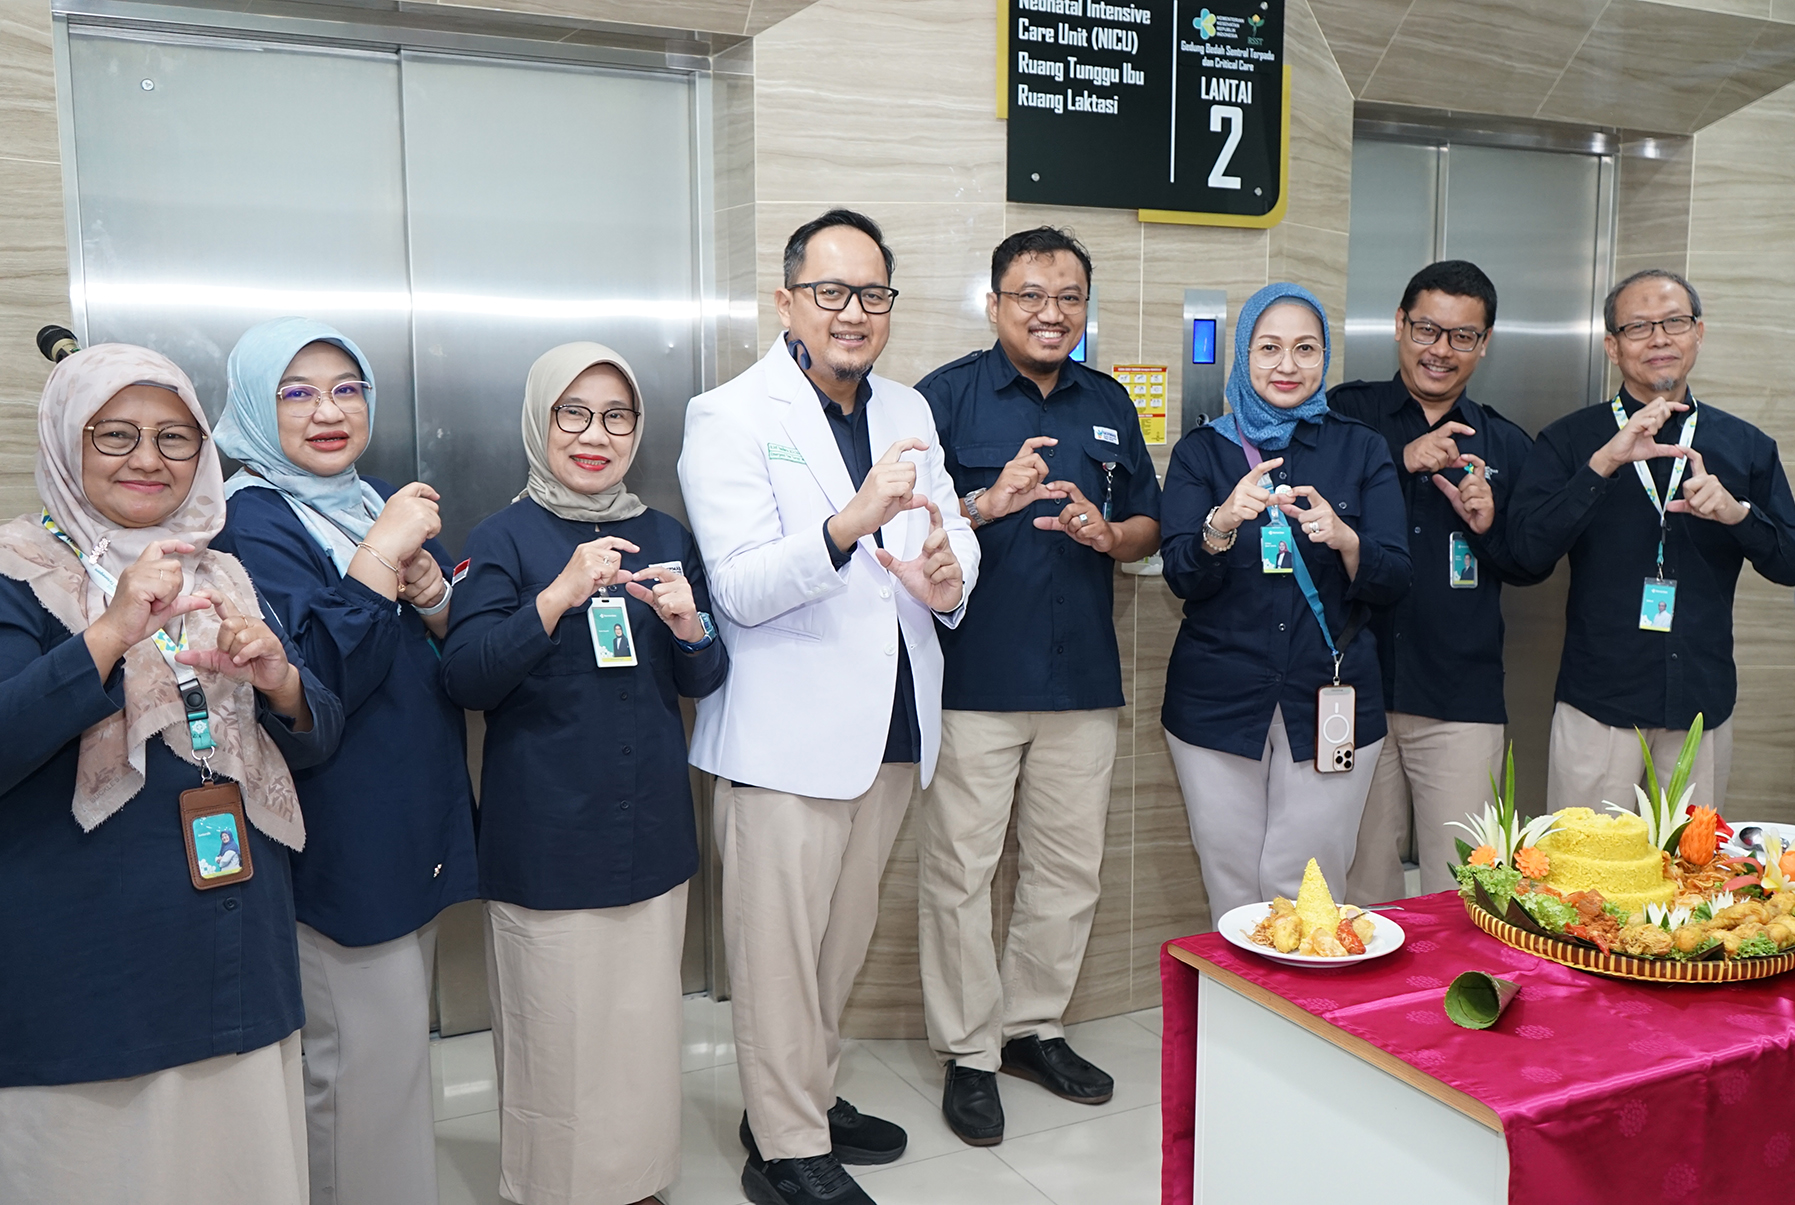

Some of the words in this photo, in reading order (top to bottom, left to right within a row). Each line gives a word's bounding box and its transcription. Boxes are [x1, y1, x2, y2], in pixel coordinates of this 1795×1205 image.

[1086, 0, 1151, 24] Intensive
[1018, 17, 1055, 43] Care
[1058, 22, 1088, 47] Unit
[1091, 26, 1139, 55] (NICU)
[1180, 40, 1205, 55] Gedung
[1205, 43, 1225, 55] Bedah
[1225, 45, 1249, 58] Sentral
[1249, 48, 1275, 61] Terpadu
[1018, 51, 1064, 81] Ruang
[1067, 56, 1120, 86] Tunggu
[1122, 62, 1145, 85] Ibu
[1201, 56, 1215, 67] dan
[1215, 57, 1238, 70] Critical
[1238, 60, 1255, 72] Care
[1017, 83, 1064, 114] Ruang
[1067, 88, 1119, 114] Laktasi
[1200, 75, 1253, 104] LANTAI
[1207, 104, 1244, 190] 2
